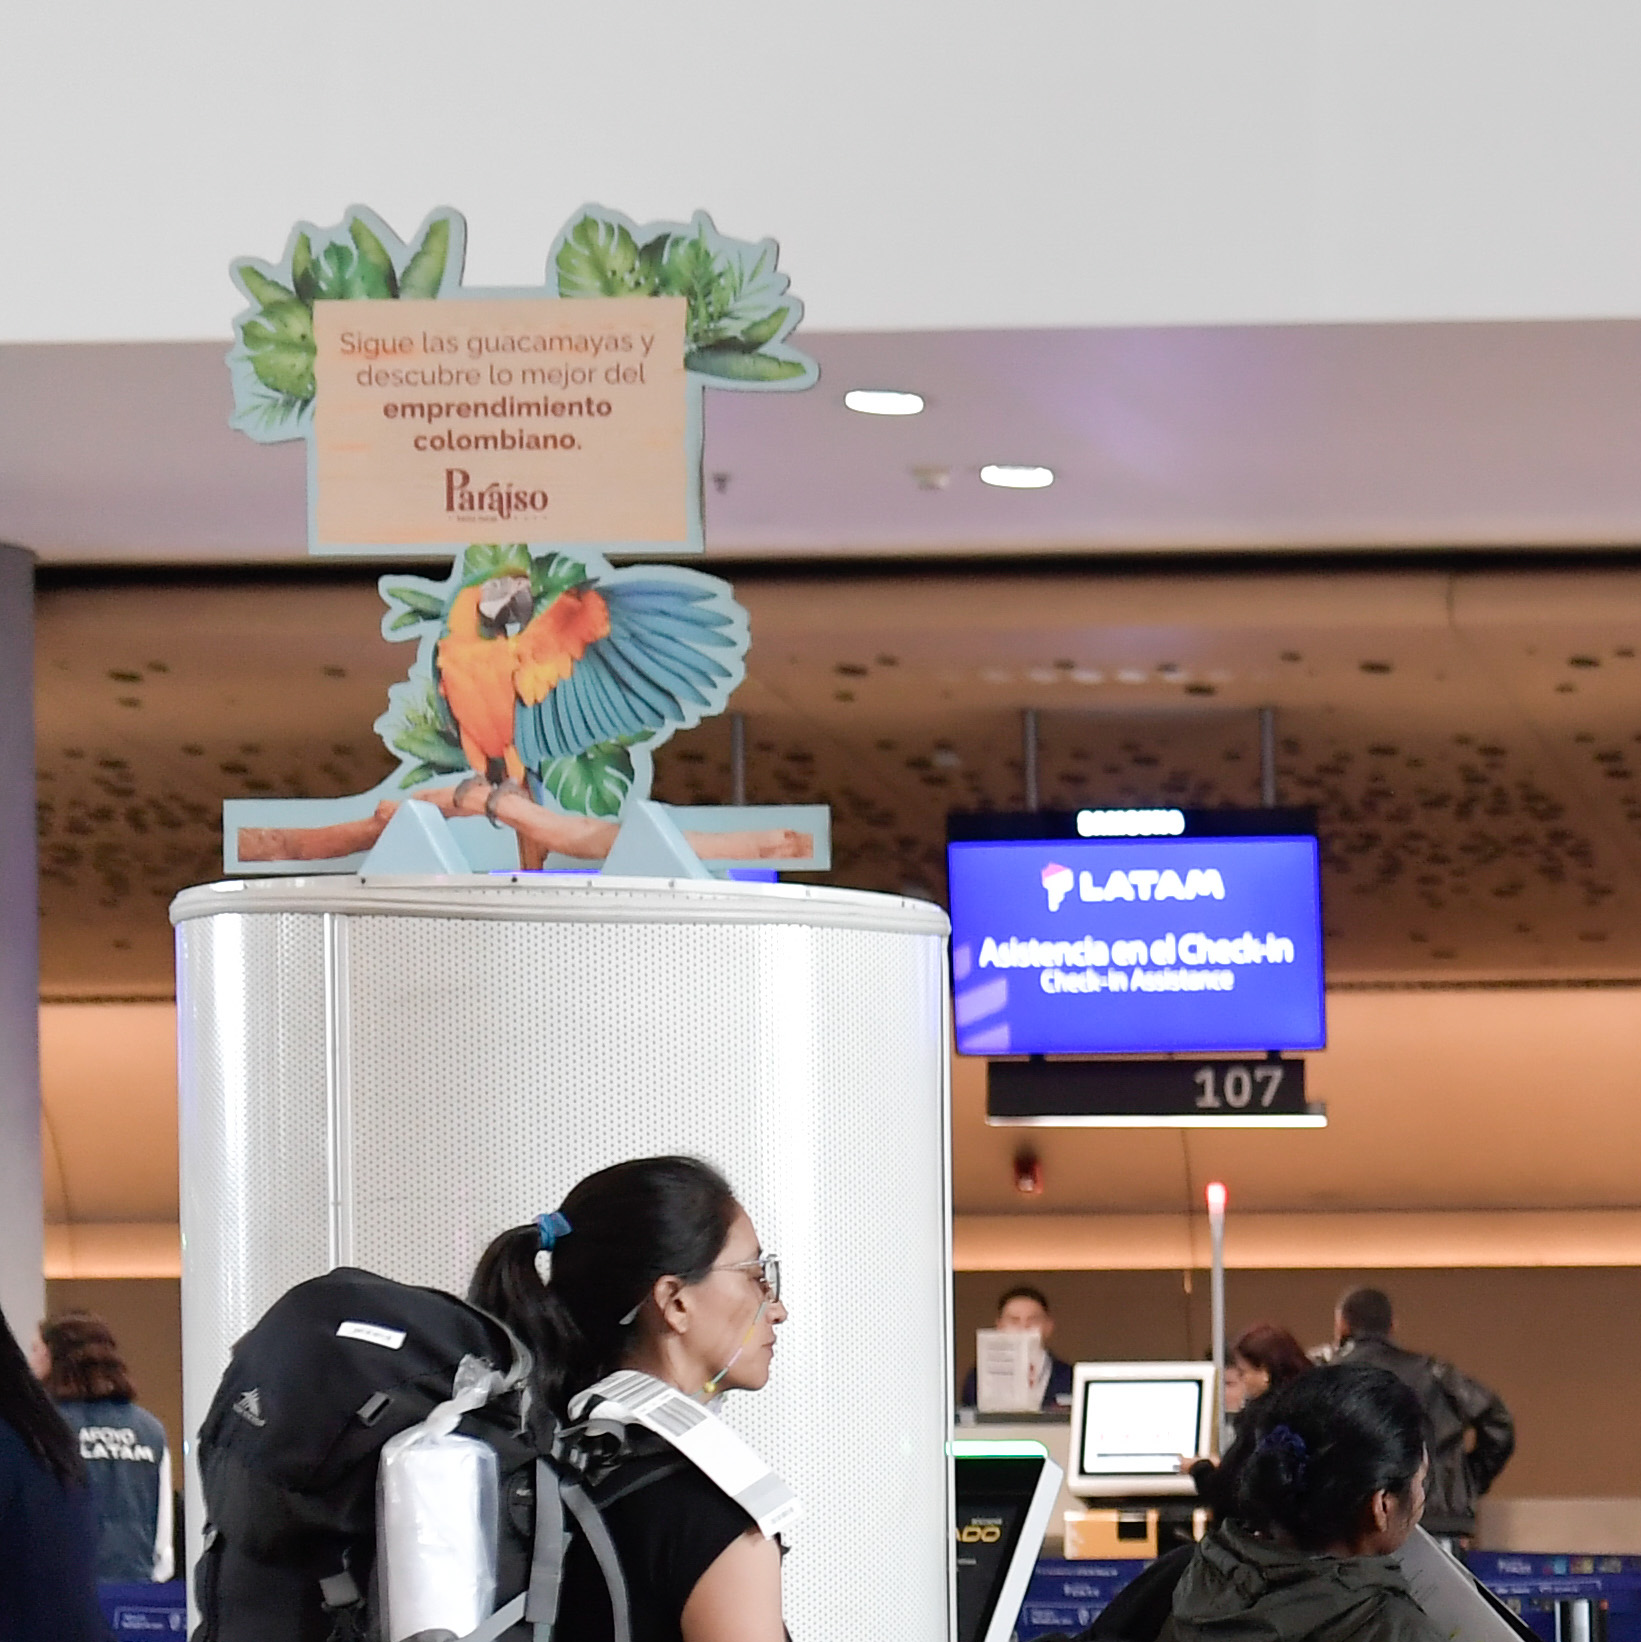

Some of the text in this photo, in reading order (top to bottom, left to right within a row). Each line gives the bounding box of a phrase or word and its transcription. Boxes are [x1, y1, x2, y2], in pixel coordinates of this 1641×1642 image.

[340, 331, 655, 360] Sigue las guacamayas y
[356, 363, 646, 390] descubre lo mejor del
[383, 395, 612, 424] emprendimiento
[413, 428, 582, 451] colombiano.
[1079, 868, 1226, 902] LATAM
[1194, 1066, 1285, 1108] 107
[79, 1426, 137, 1446] APOYO
[80, 1442, 155, 1463] LATAM
